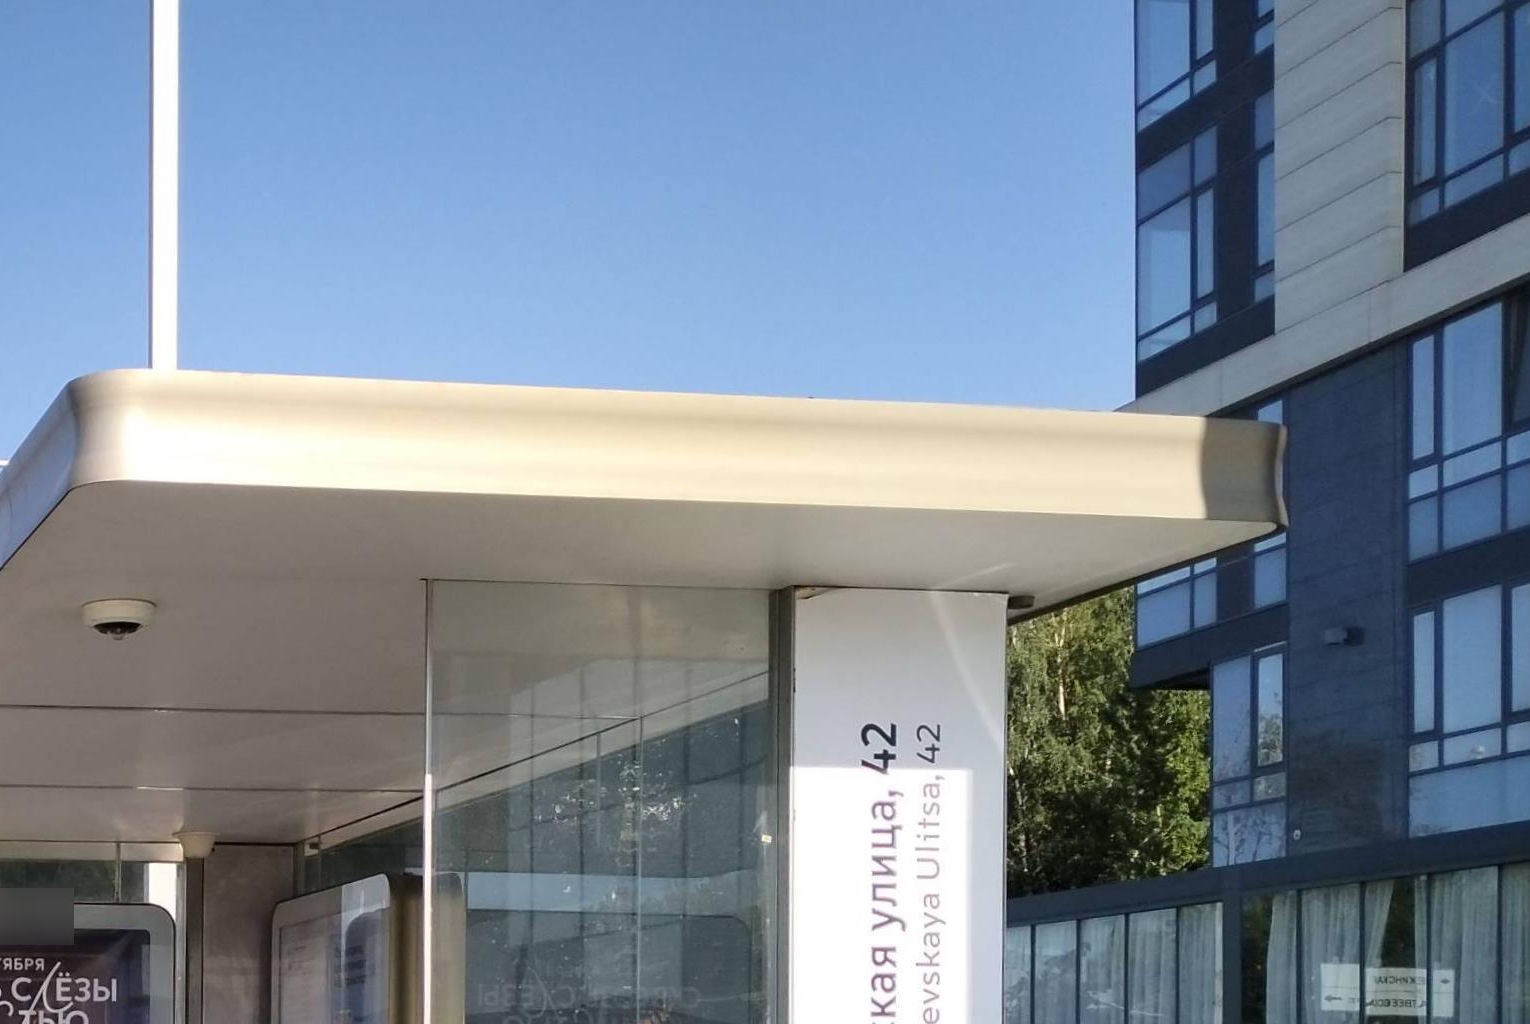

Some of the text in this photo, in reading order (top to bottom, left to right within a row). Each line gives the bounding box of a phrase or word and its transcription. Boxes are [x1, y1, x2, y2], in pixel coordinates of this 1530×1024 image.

[861, 722, 897, 775] 42
[916, 724, 941, 764] 42
[914, 775, 945, 880] Ulitsa,
[871, 790, 907, 933] улица,
[10, 961, 118, 1014] СЛЁЗЫ
